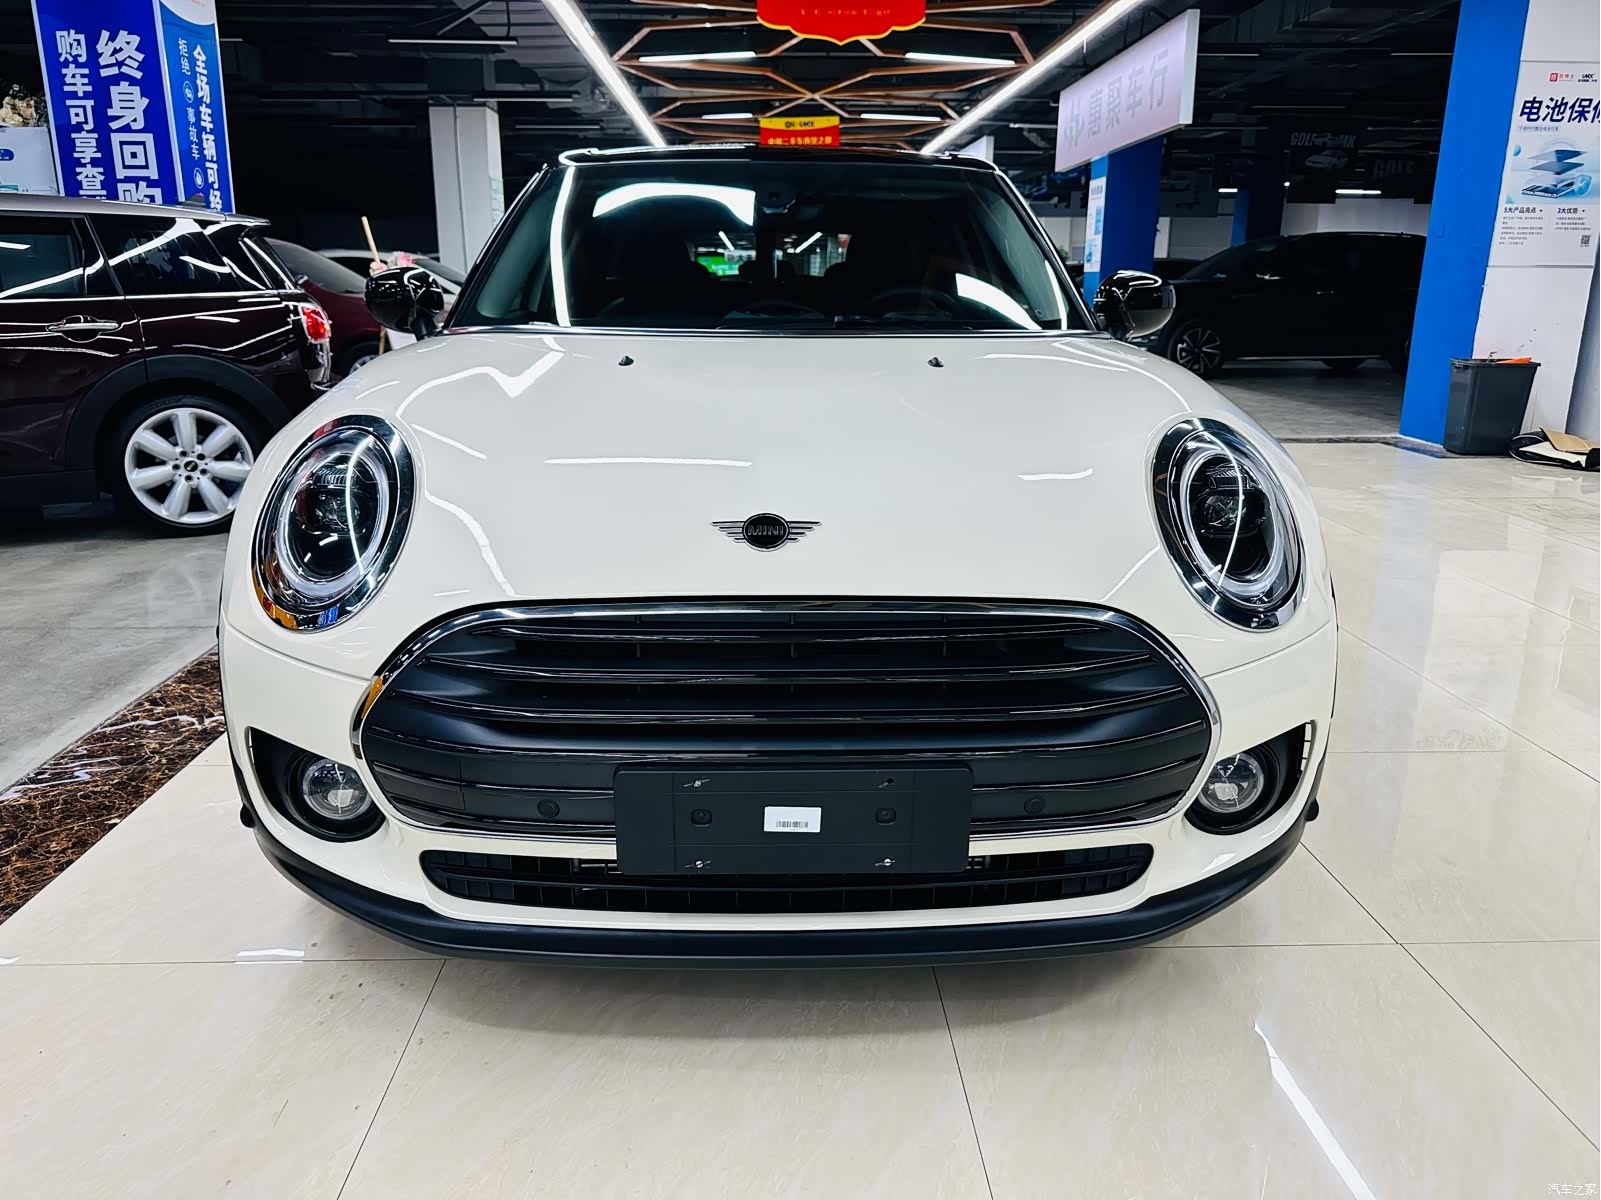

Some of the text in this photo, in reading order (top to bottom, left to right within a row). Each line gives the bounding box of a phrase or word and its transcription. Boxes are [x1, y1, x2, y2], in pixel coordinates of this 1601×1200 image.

[178, 37, 200, 161] 拒绝 事故车
[56, 29, 107, 200] 购车可享查
[1503, 206, 1537, 214] 5大产品亮点
[1556, 207, 1579, 215] 3大优势
[747, 525, 784, 536] MINI
